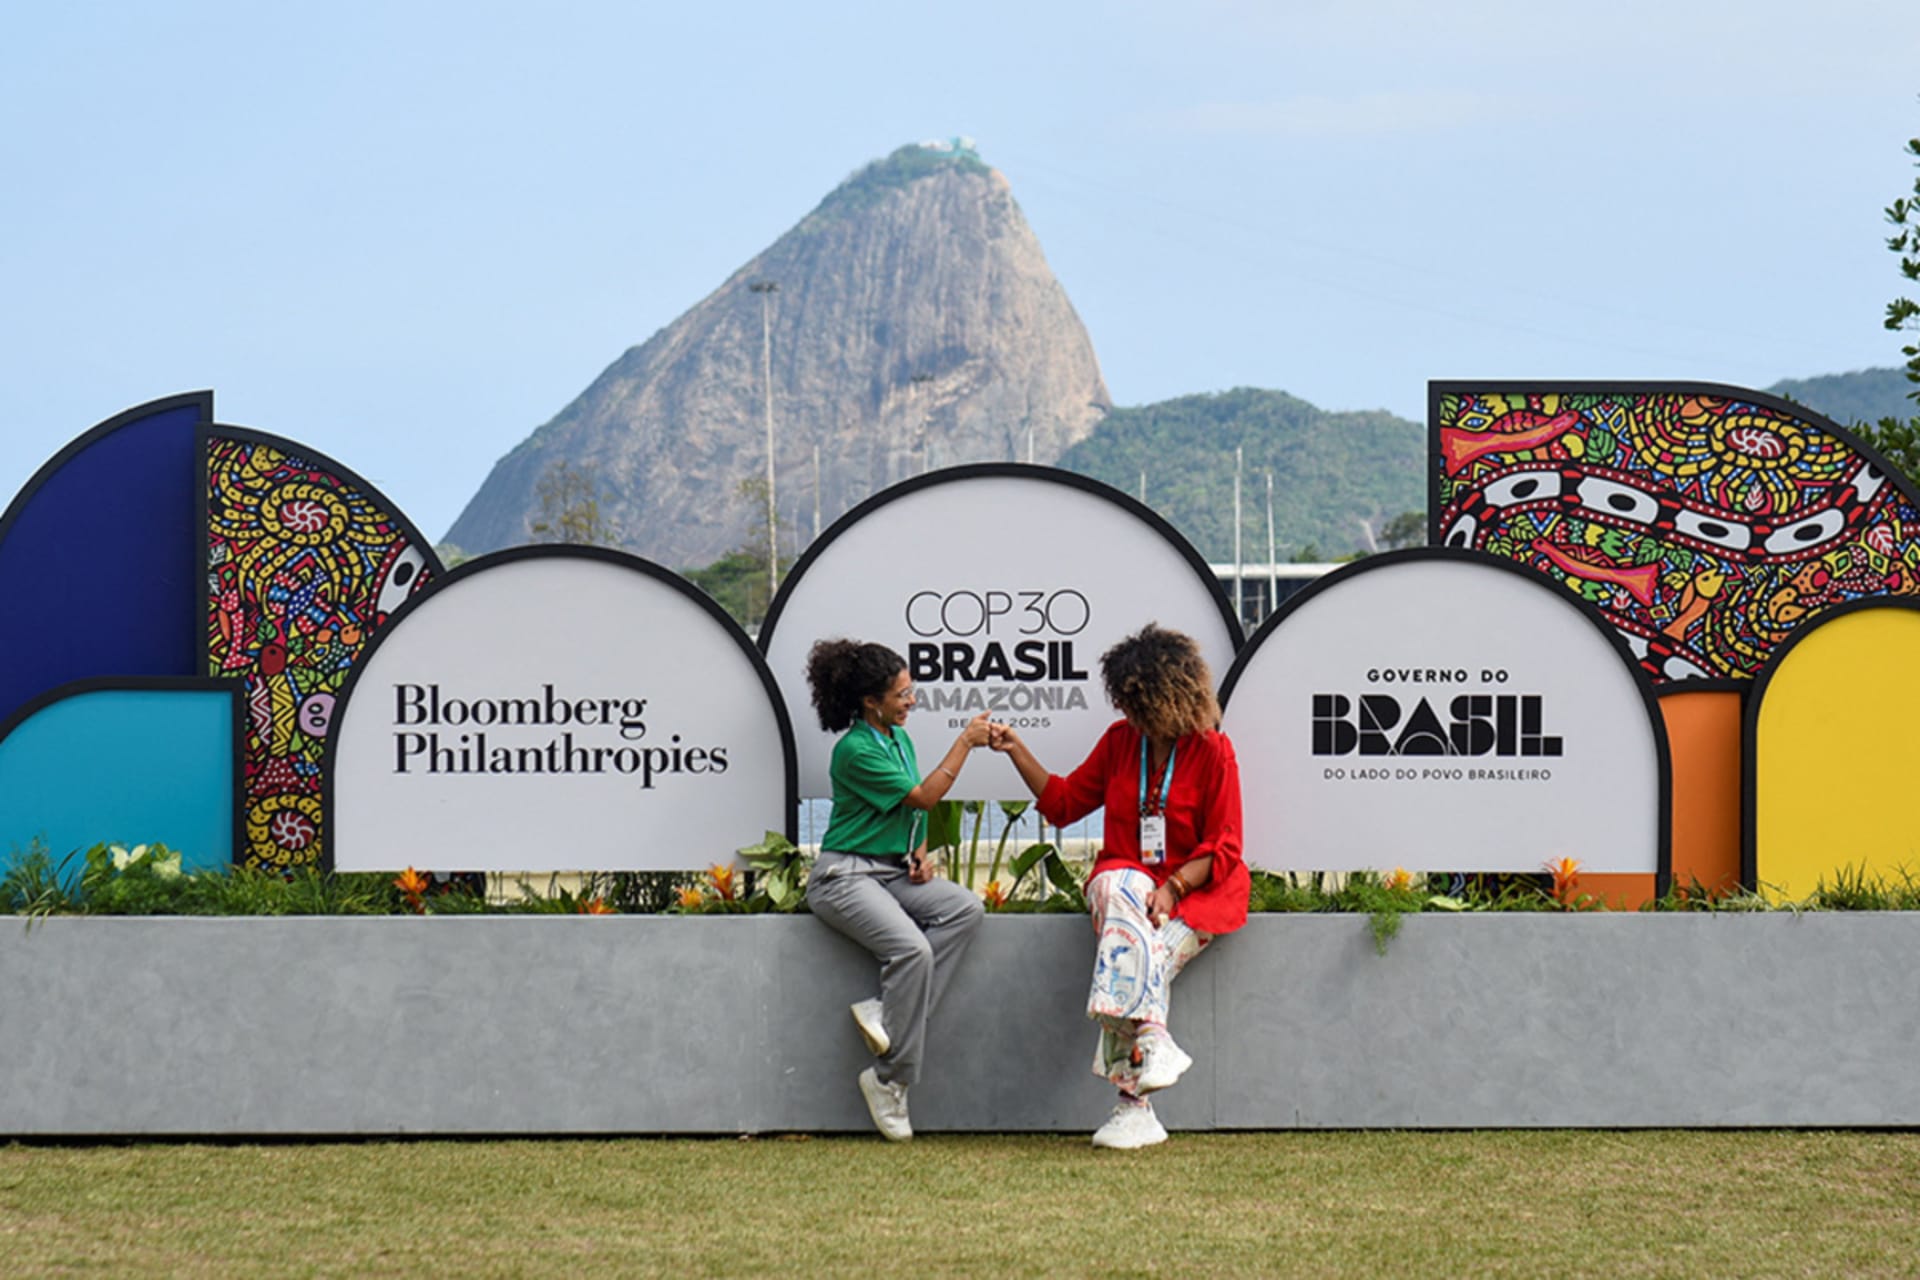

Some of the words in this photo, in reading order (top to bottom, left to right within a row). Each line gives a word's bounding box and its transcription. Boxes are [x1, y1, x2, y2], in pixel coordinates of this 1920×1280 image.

[909, 641, 1088, 682] BRASIL
[1367, 668, 1467, 683] GOVERNO
[1481, 669, 1509, 683] DO
[393, 684, 647, 739] Bloomberg
[911, 684, 1088, 712] AMAZÔNIA
[1009, 717, 1051, 729] 2025
[1312, 694, 1563, 757] BRASIL
[393, 732, 729, 789] Philanthropies
[1324, 768, 1346, 780] DO
[1351, 768, 1390, 780] LADO
[1396, 768, 1418, 780] DO
[1423, 768, 1463, 780] POVO
[1468, 769, 1552, 781] BRASILEIRO
